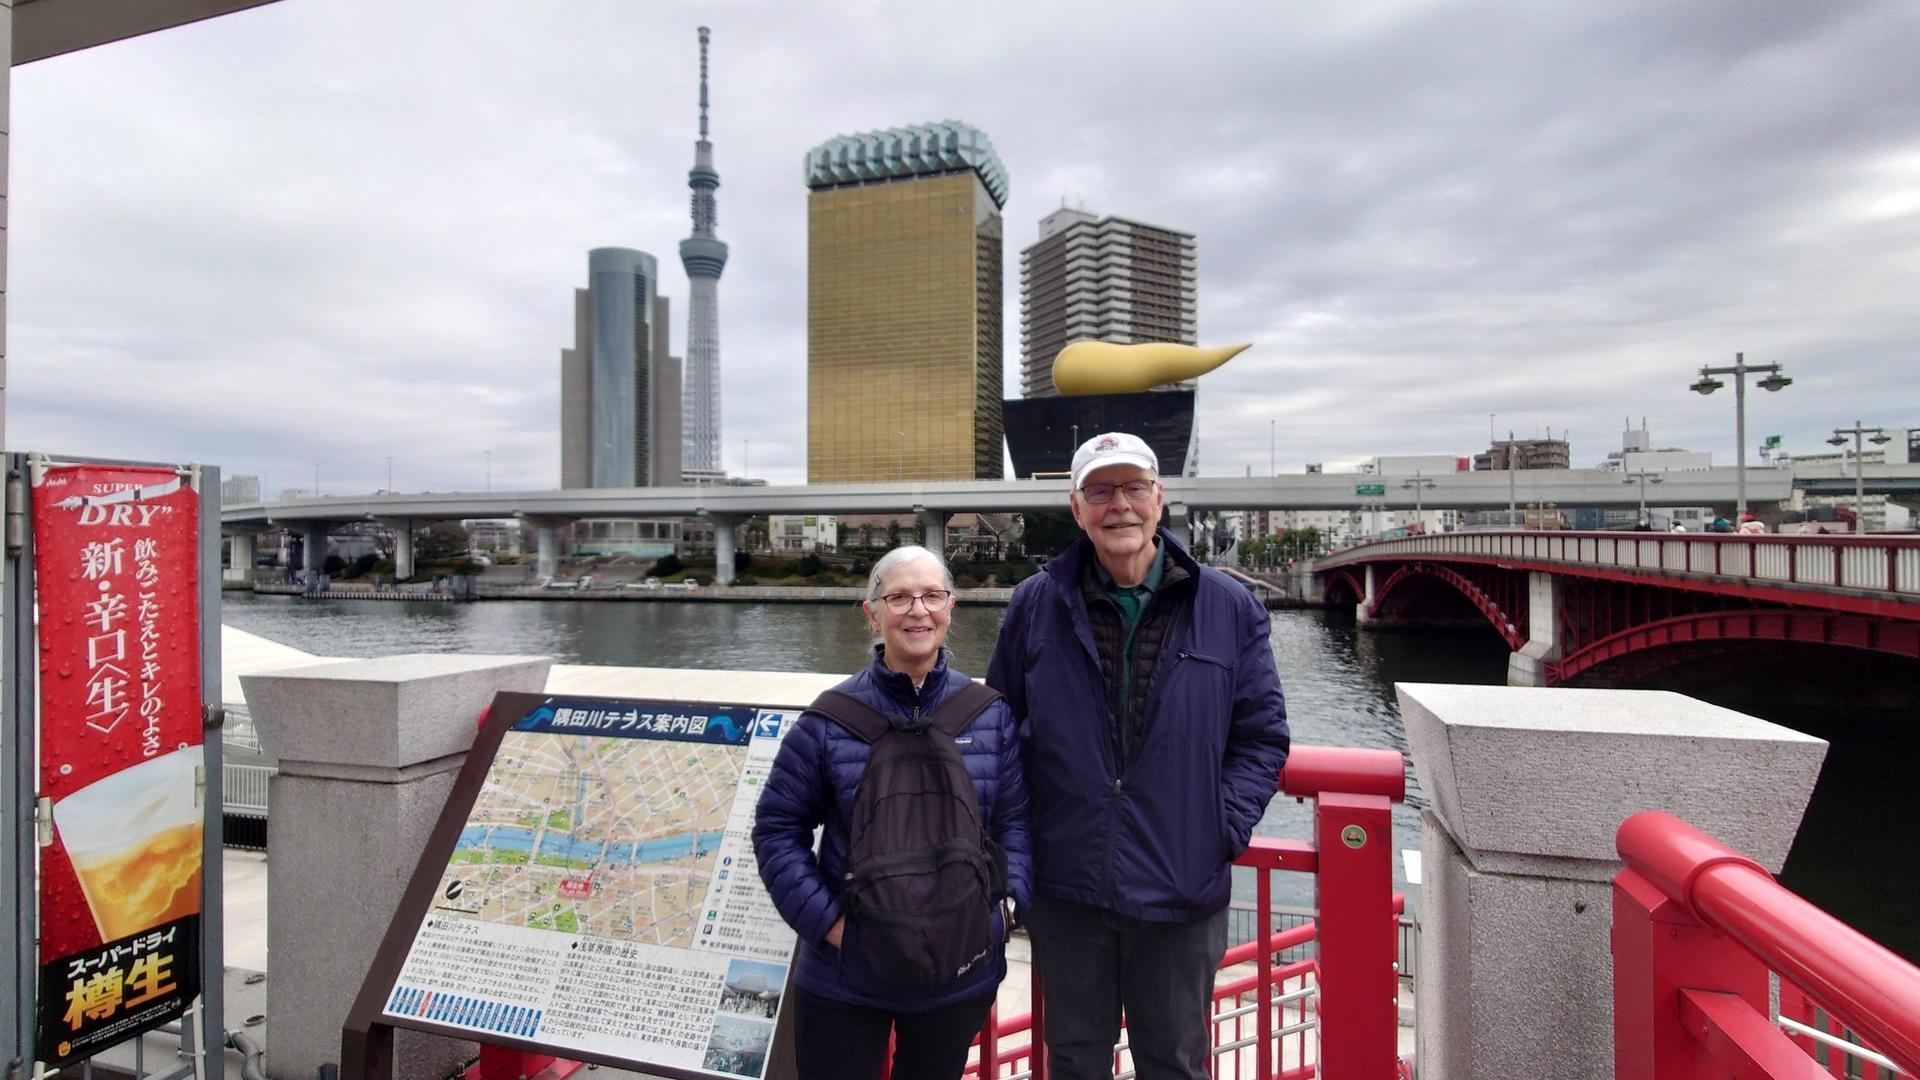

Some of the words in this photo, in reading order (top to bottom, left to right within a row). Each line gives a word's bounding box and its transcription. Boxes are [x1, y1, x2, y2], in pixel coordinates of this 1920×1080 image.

[133, 537, 160, 756] 飲みごたえとキレのよさ
[551, 707, 708, 735] 隅田川テラス案内図
[67, 926, 177, 979] スーパードライ
[579, 942, 638, 959] 浅草界隈の歴史
[63, 951, 177, 1031] 樽生
